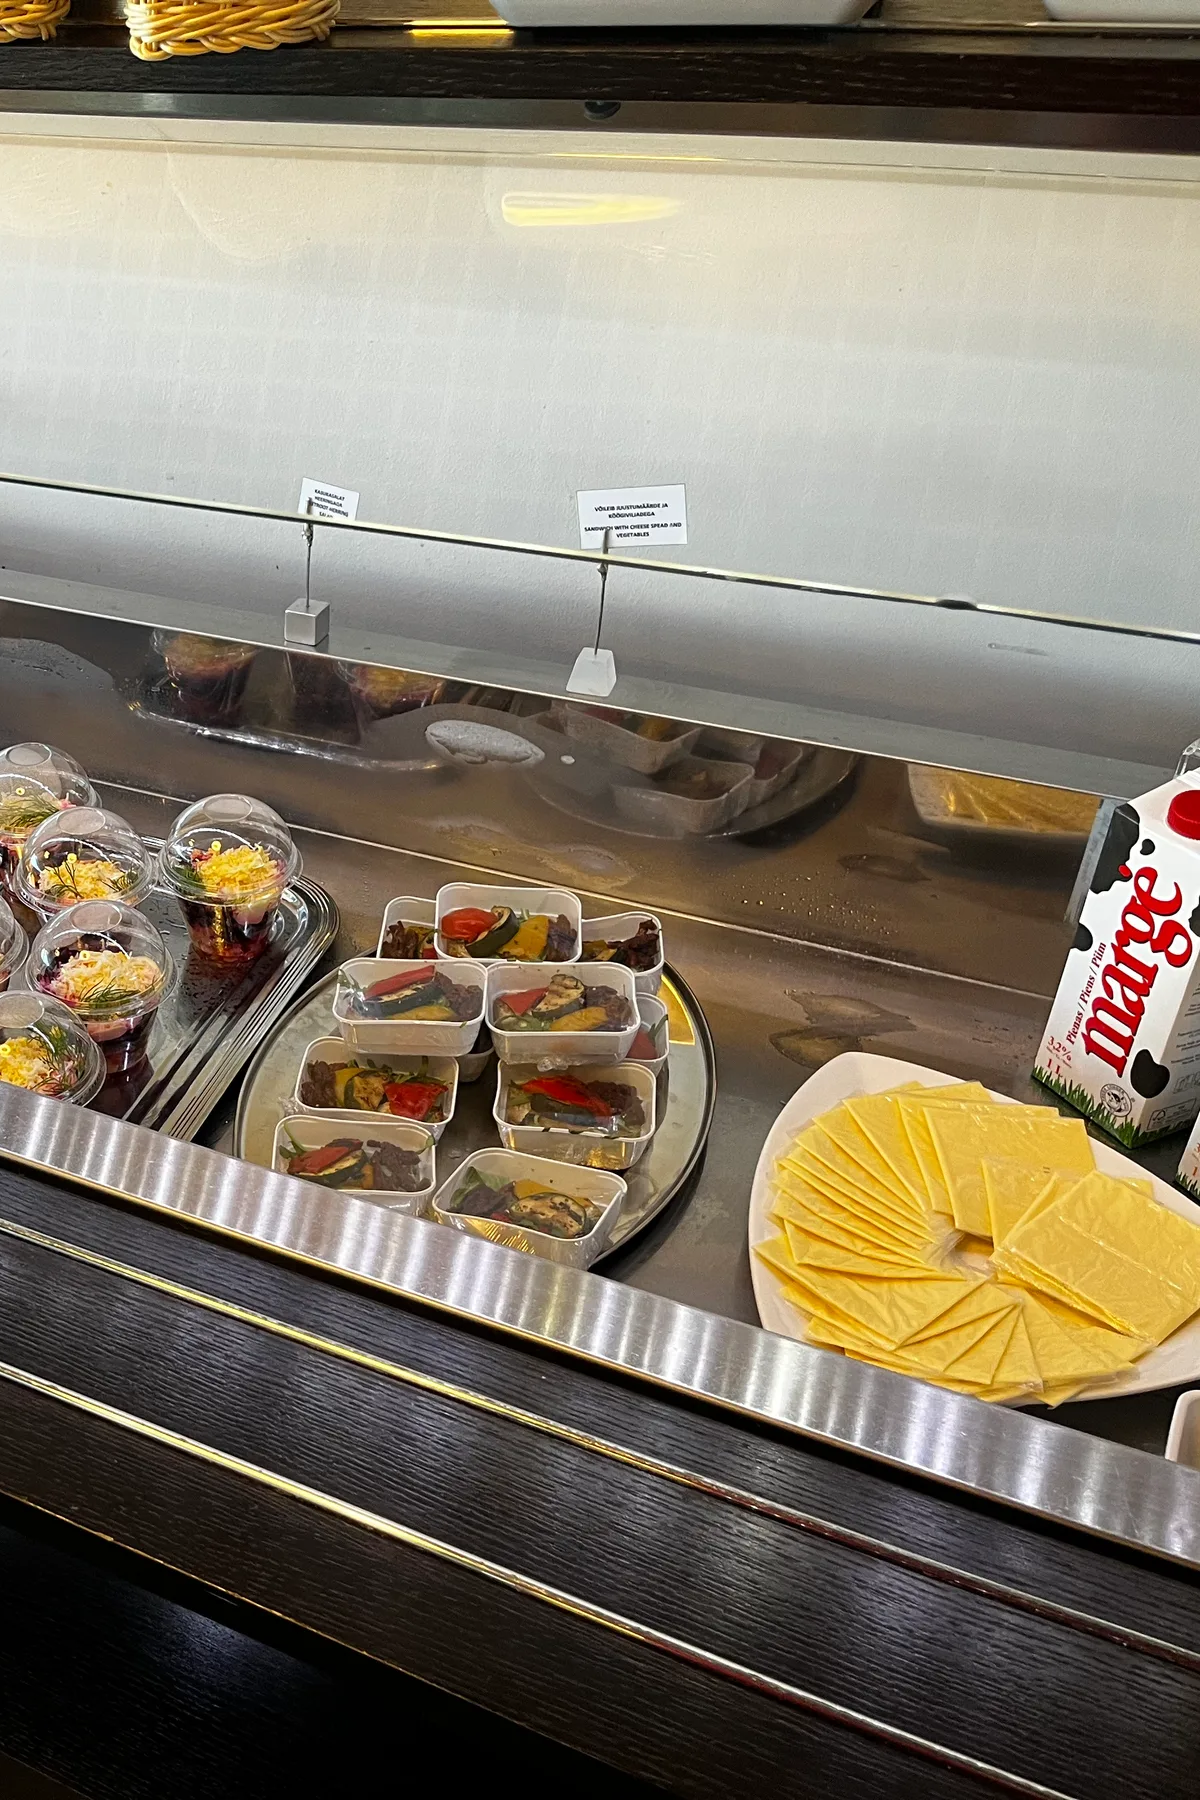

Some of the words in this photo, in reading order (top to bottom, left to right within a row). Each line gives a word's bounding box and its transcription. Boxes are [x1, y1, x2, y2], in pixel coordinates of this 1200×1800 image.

[1066, 1010, 1084, 1045] Pienas
[1080, 974, 1096, 1005] Piens
[1091, 942, 1107, 968] Piim
